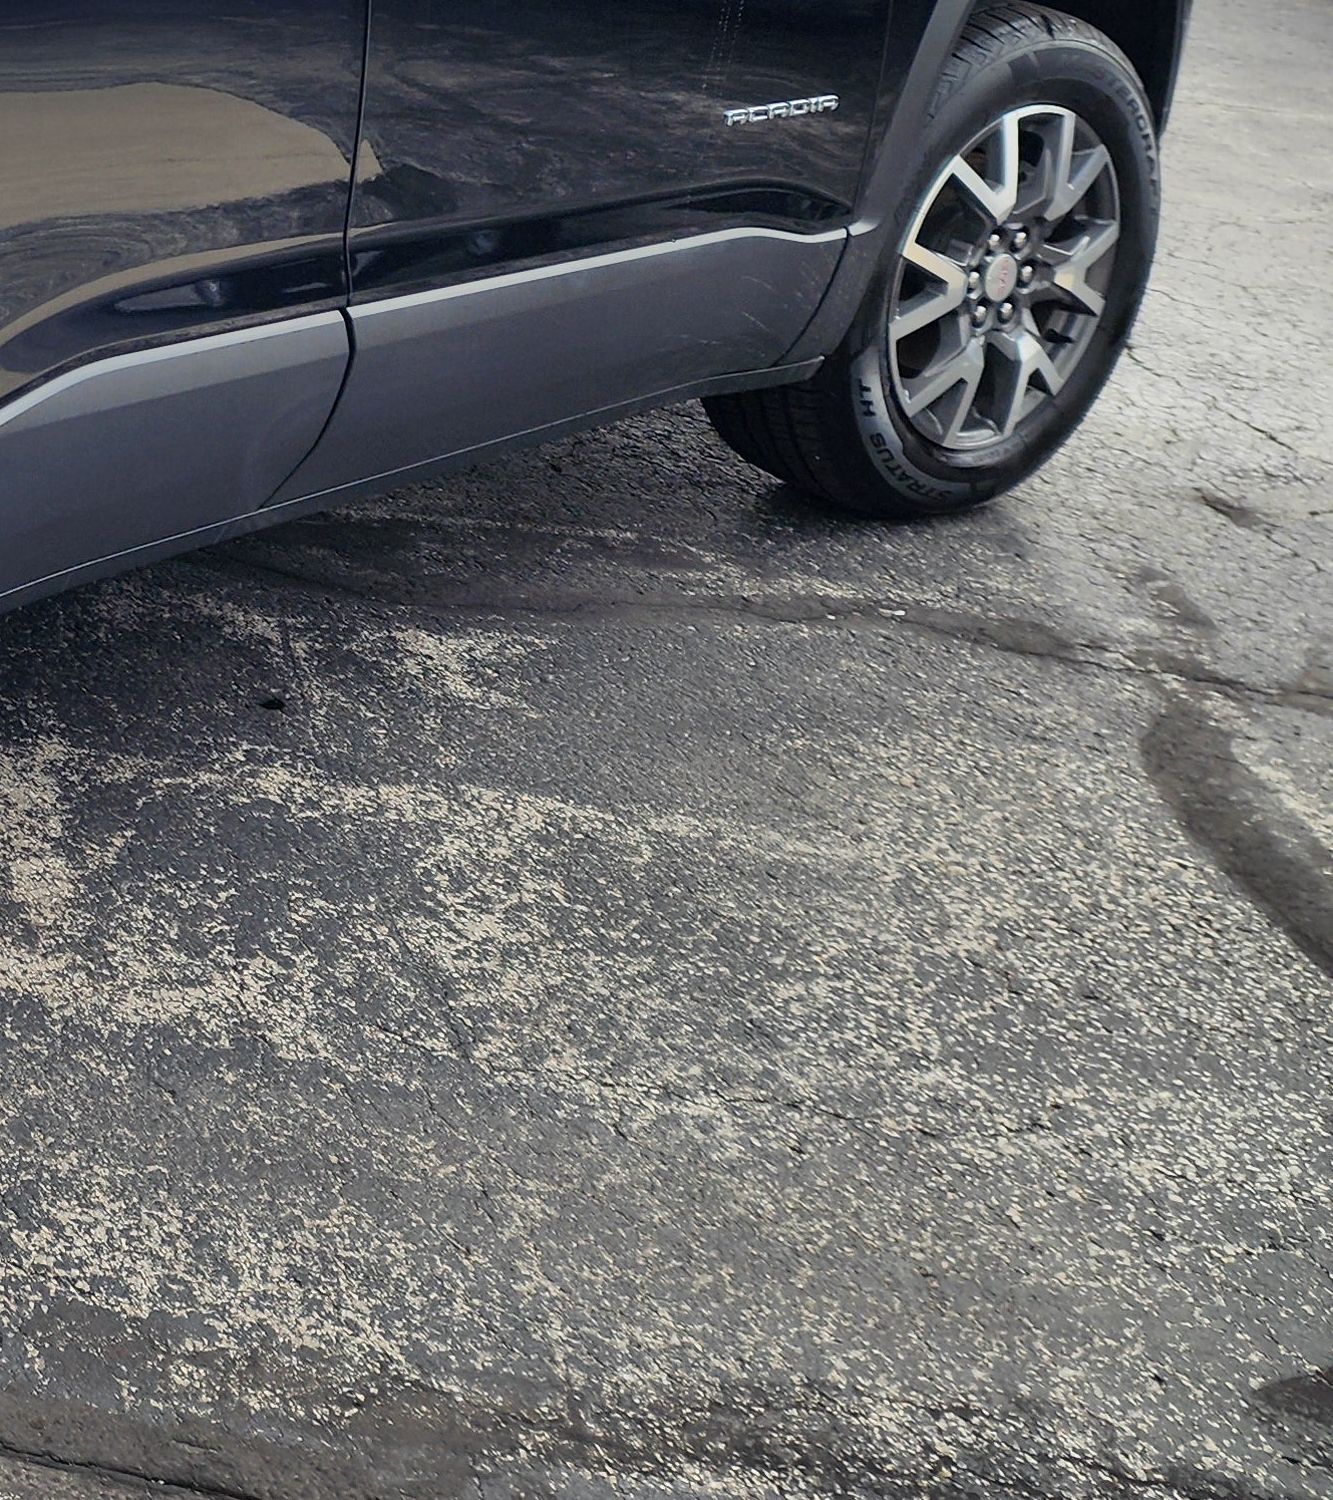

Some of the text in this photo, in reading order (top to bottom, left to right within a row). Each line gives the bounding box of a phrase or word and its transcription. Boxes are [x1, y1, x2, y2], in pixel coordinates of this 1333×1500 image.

[723, 94, 840, 127] ACADIA
[858, 378, 954, 502] STRATUS HT
